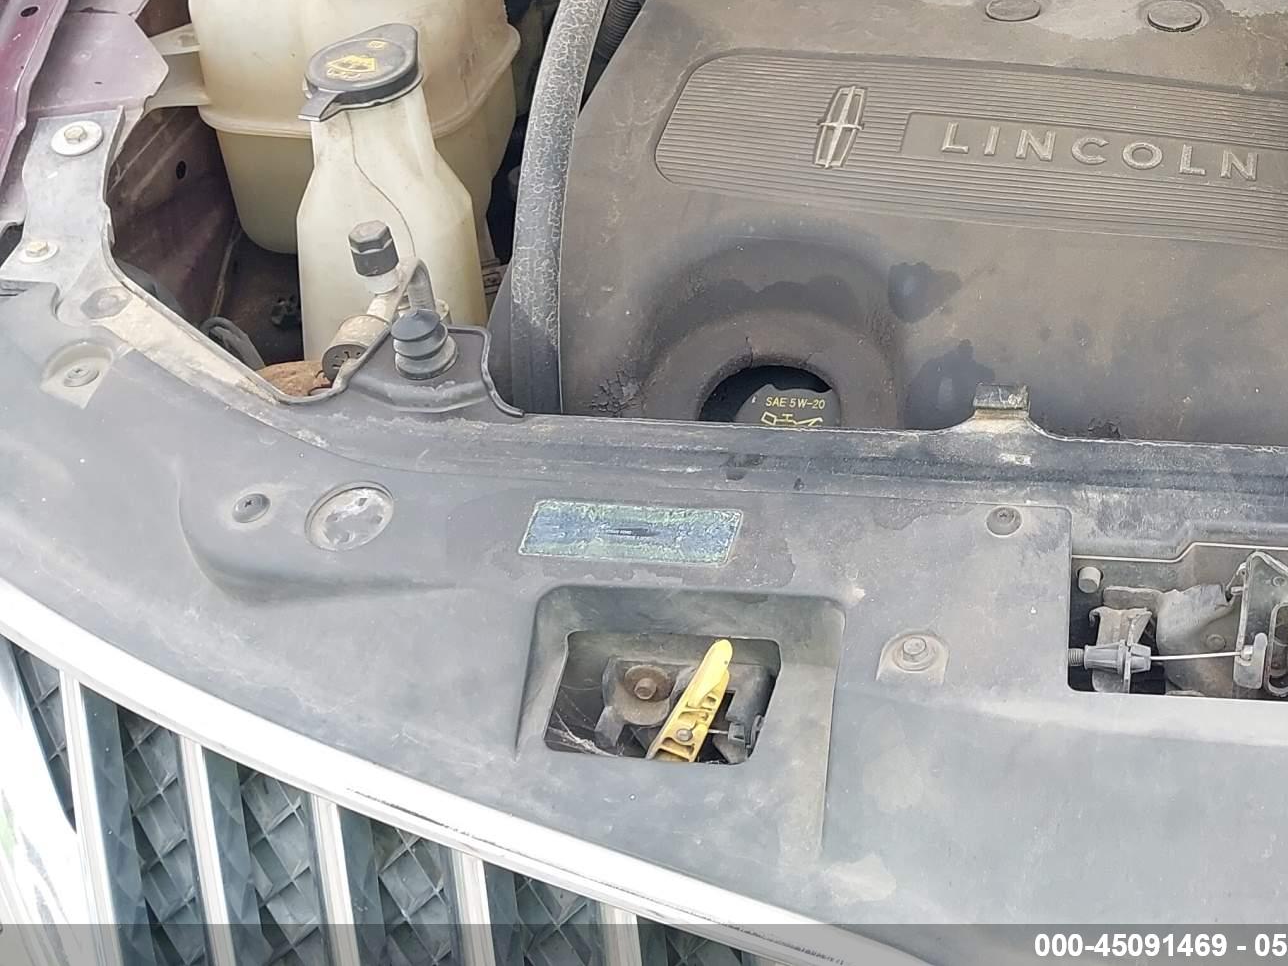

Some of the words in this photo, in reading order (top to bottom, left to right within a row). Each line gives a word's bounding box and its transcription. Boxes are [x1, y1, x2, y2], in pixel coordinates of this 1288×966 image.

[941, 122, 1259, 181] LINCOLN
[765, 396, 788, 408] SAE
[789, 397, 826, 410] 5W-20
